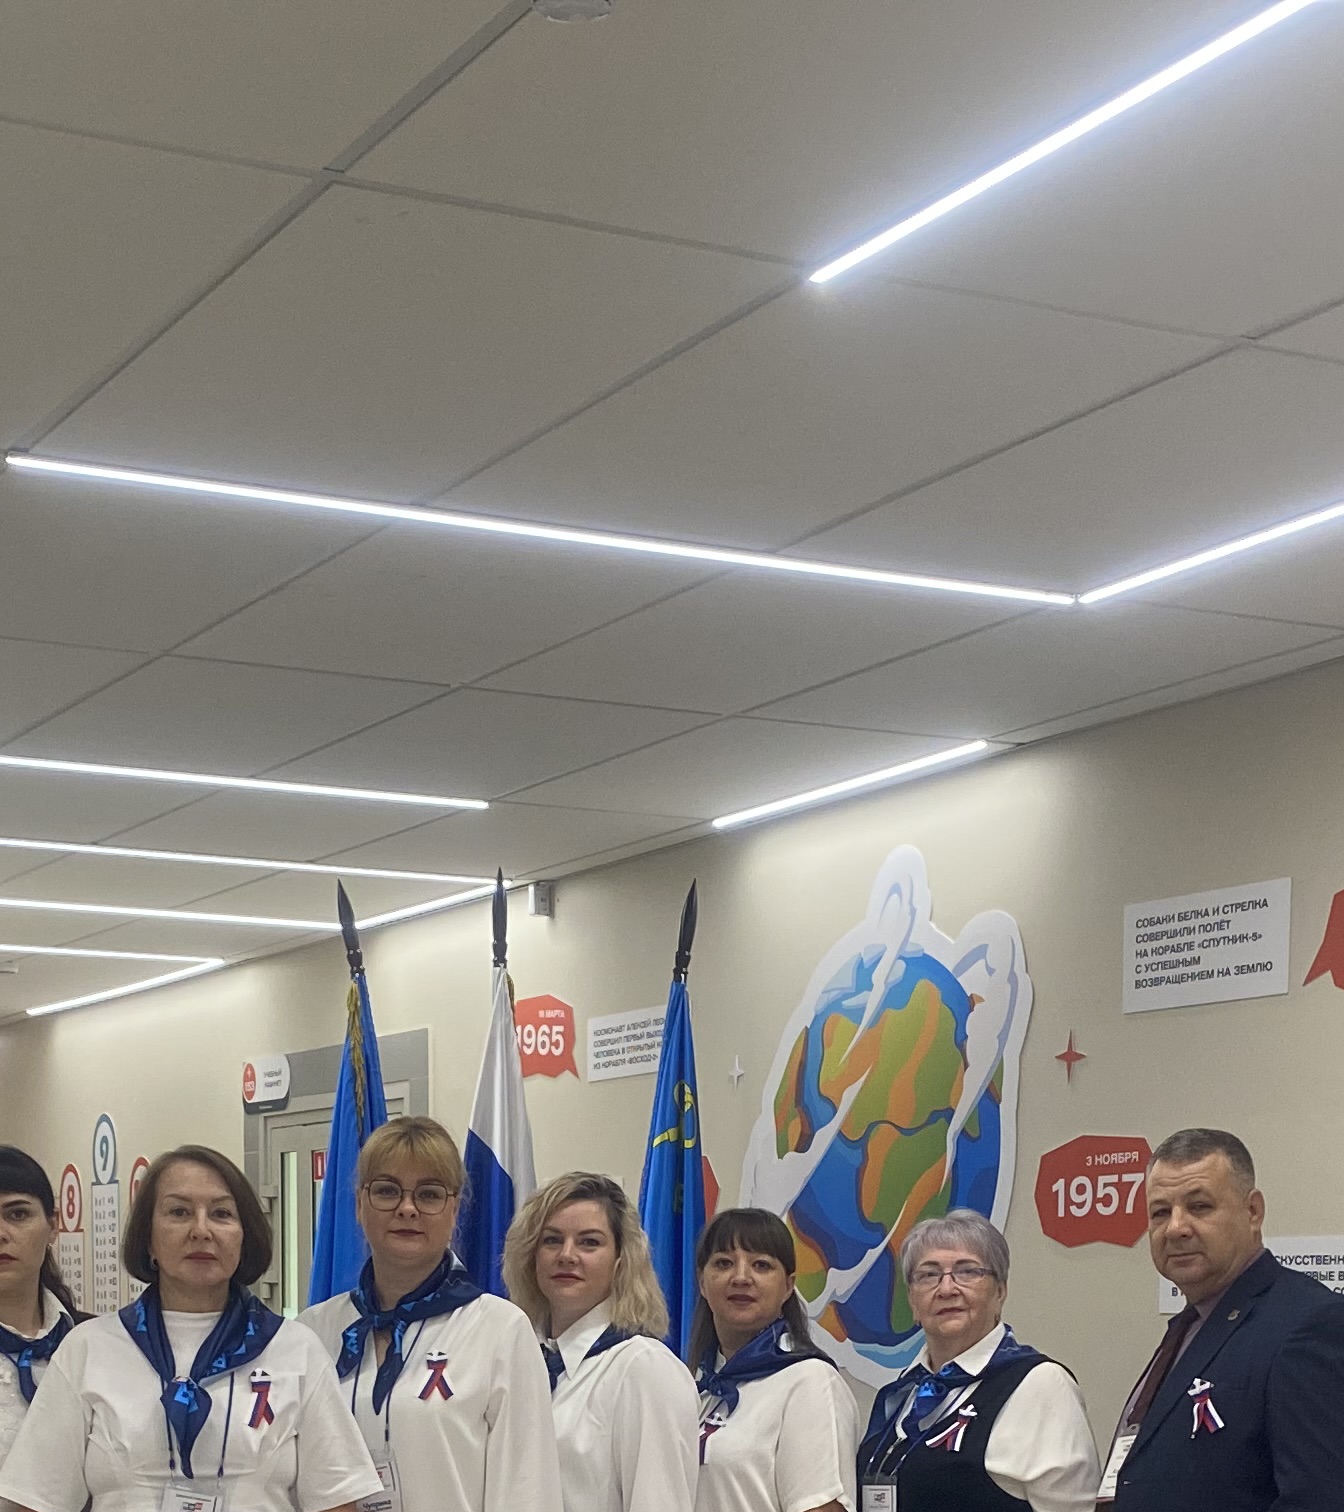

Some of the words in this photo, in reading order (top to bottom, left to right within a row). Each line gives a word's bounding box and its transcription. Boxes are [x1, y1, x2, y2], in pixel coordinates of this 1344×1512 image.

[1136, 914, 1175, 929] СОБАКИ
[1178, 907, 1209, 922] БЕЛКА
[1212, 906, 1220, 917] И
[1222, 898, 1269, 914] СТРЕЛКА
[1135, 949, 1149, 959] НА
[1151, 941, 1195, 957] КОРАБЛЕ
[1198, 931, 1262, 949] «СПУТНИК-5»
[1136, 926, 1196, 944] СОВЕРШИЛИ
[1198, 919, 1232, 935] ПОЛЁТ
[1135, 964, 1142, 974] С
[1144, 956, 1201, 973] УСПЕШНЫМ
[1135, 969, 1214, 990] ВОЗВРАЩЕНИЕМ
[1217, 967, 1231, 978] НА
[1234, 961, 1273, 976] ЗЕМЛЮ
[516, 1024, 564, 1056] 1965
[100, 1135, 109, 1171] 9
[1085, 1156, 1092, 1166] 3
[1095, 1151, 1139, 1165] НОЯБРЯ
[67, 1184, 75, 1219] 8
[1052, 1172, 1145, 1217] 1957
